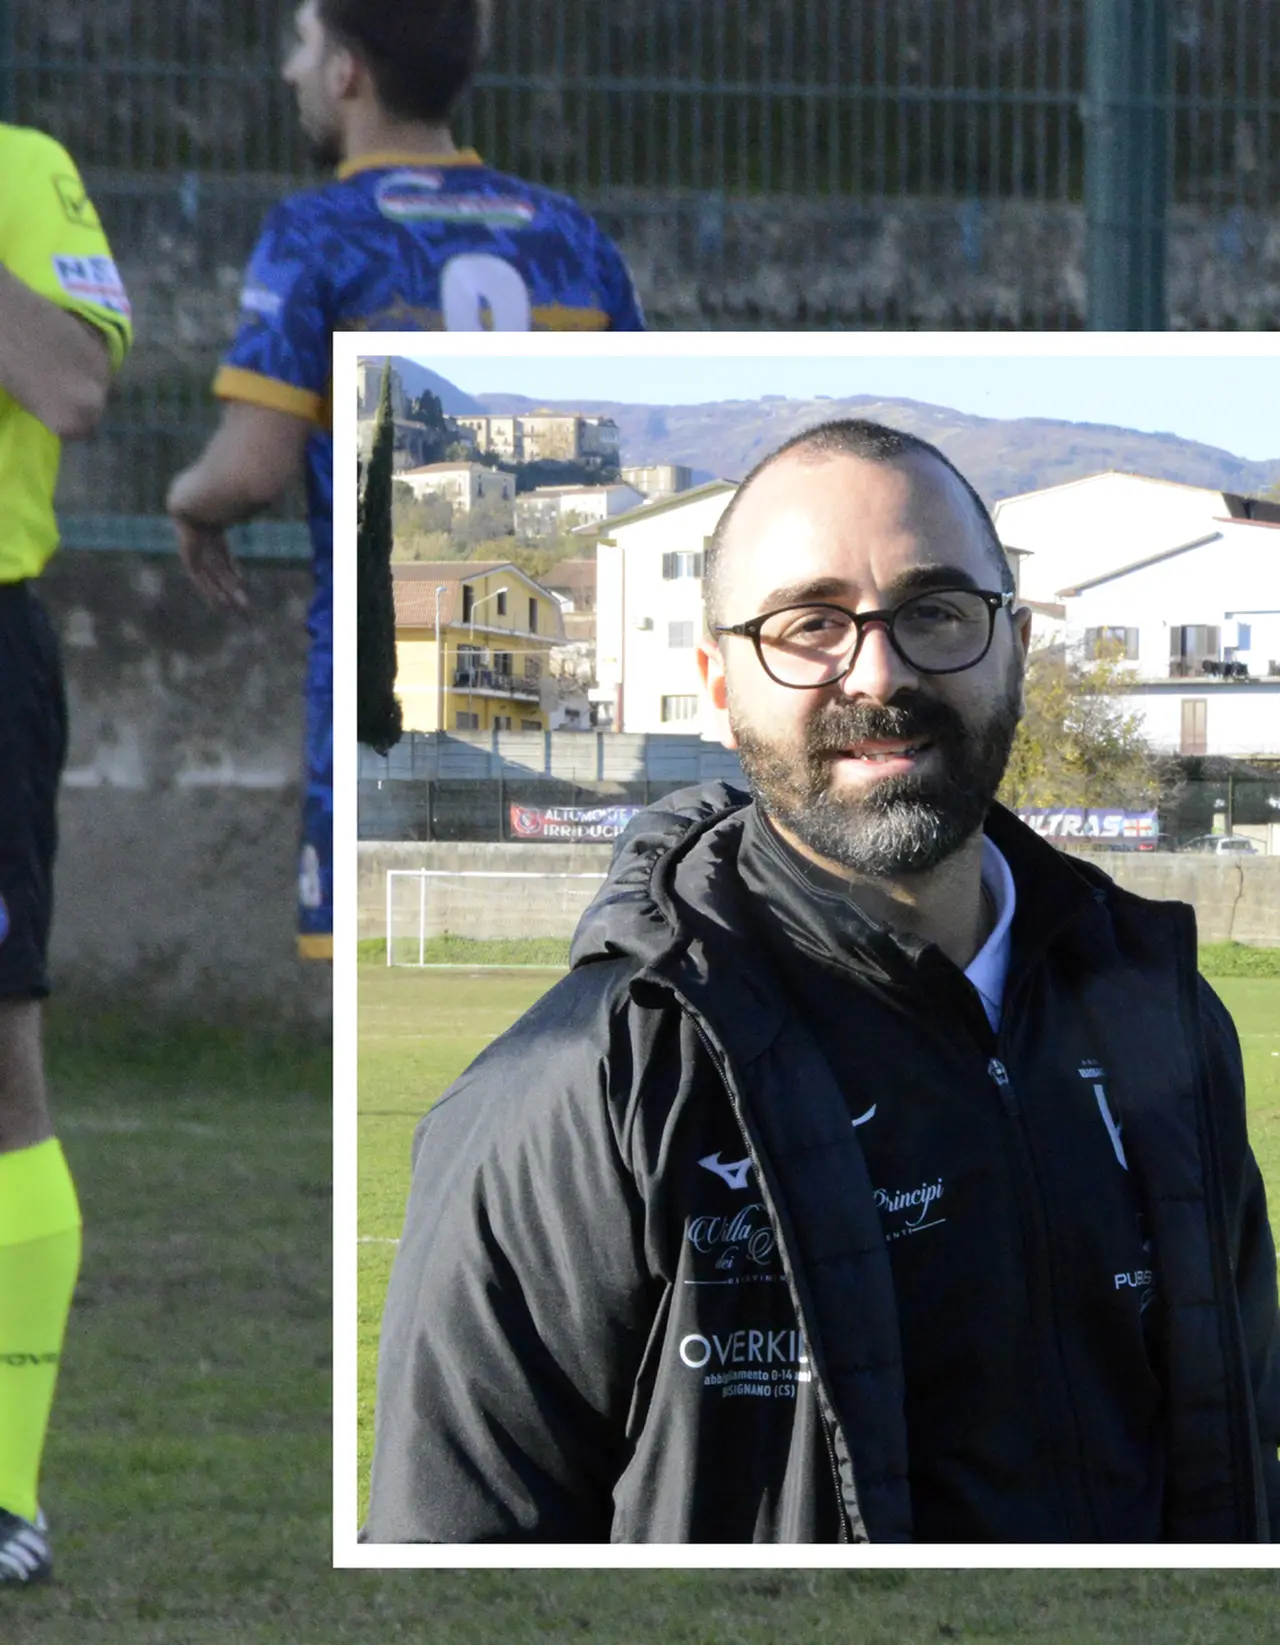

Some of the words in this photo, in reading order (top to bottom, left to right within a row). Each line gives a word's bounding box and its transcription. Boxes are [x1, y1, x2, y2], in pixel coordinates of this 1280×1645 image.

[873, 1178, 944, 1227] Principi
[688, 1204, 766, 1253] Villa
[704, 1370, 769, 1386] abbigamento
[771, 1369, 792, 1382] 0-14
[774, 1384, 796, 1398] (CS)
